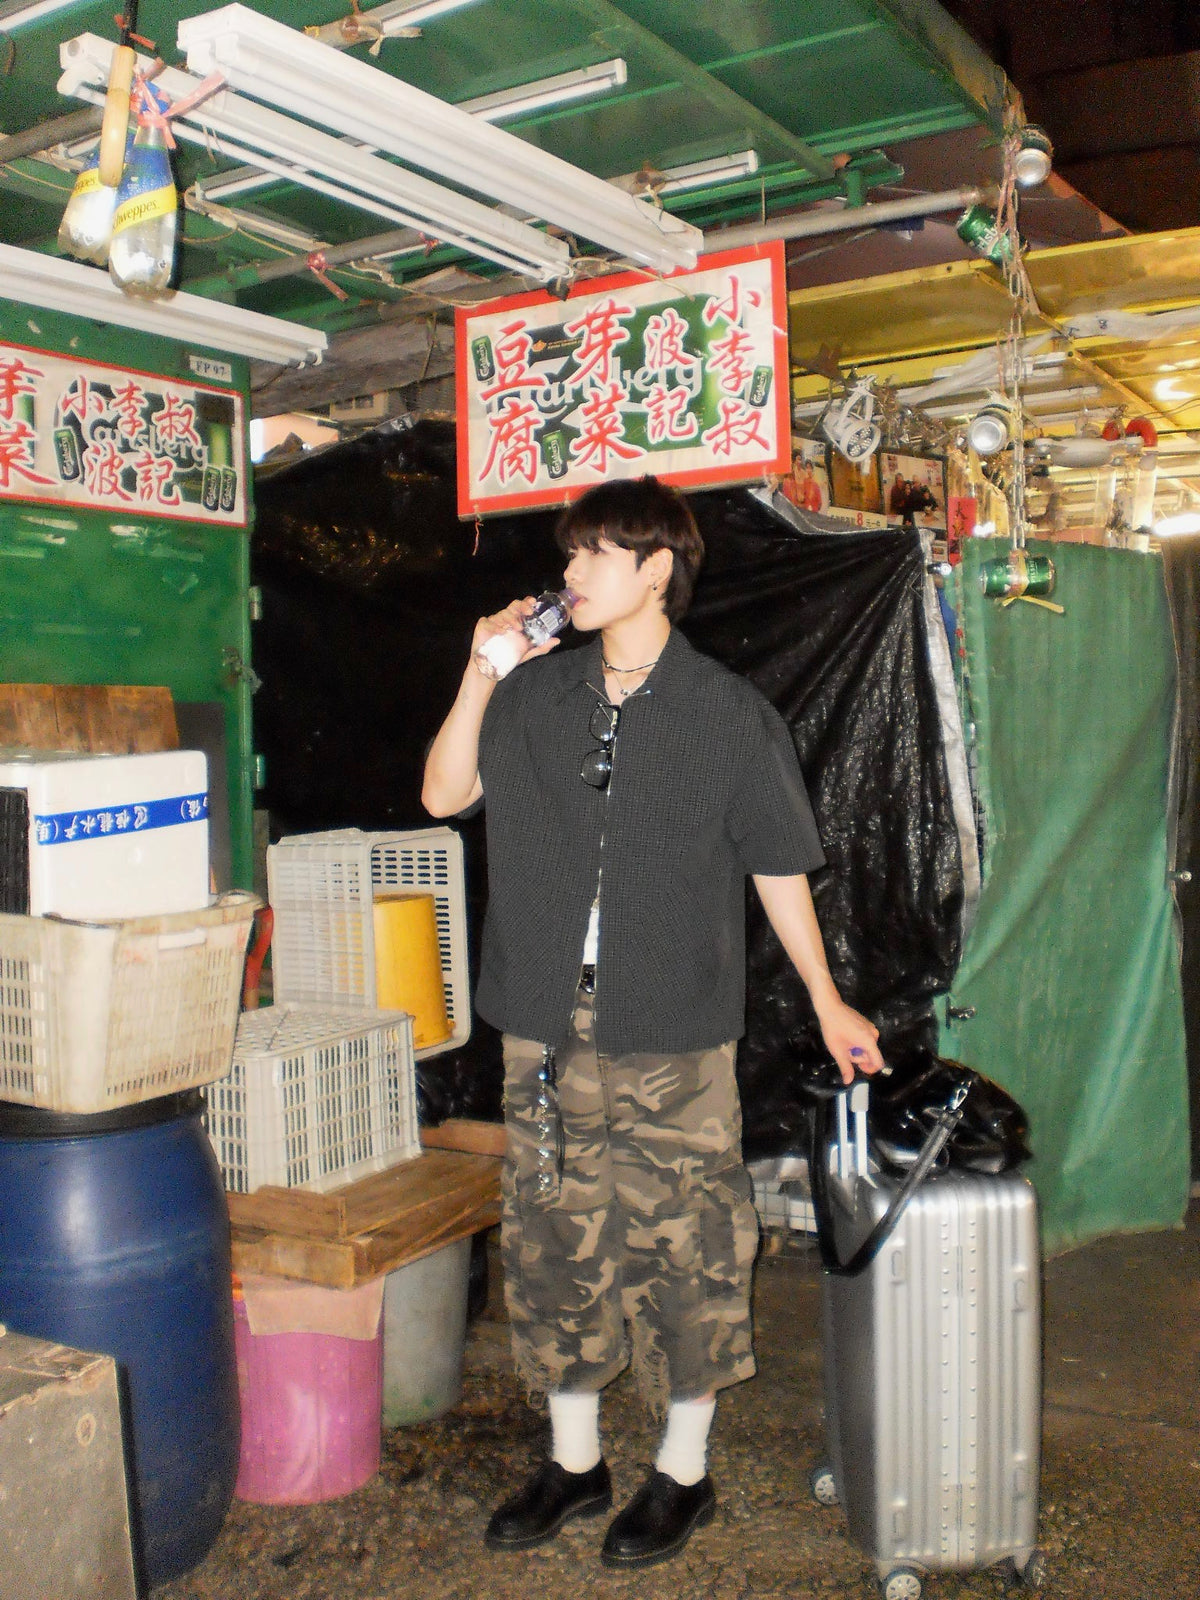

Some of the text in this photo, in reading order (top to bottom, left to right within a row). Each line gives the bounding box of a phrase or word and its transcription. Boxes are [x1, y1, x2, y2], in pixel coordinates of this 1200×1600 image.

[61, 375, 199, 447] 小李叔
[479, 320, 545, 484] 豆腐
[568, 299, 644, 474] 芽菜
[646, 311, 696, 440] 波記
[706, 275, 770, 456] 小李叔
[84, 442, 180, 506] 波記
